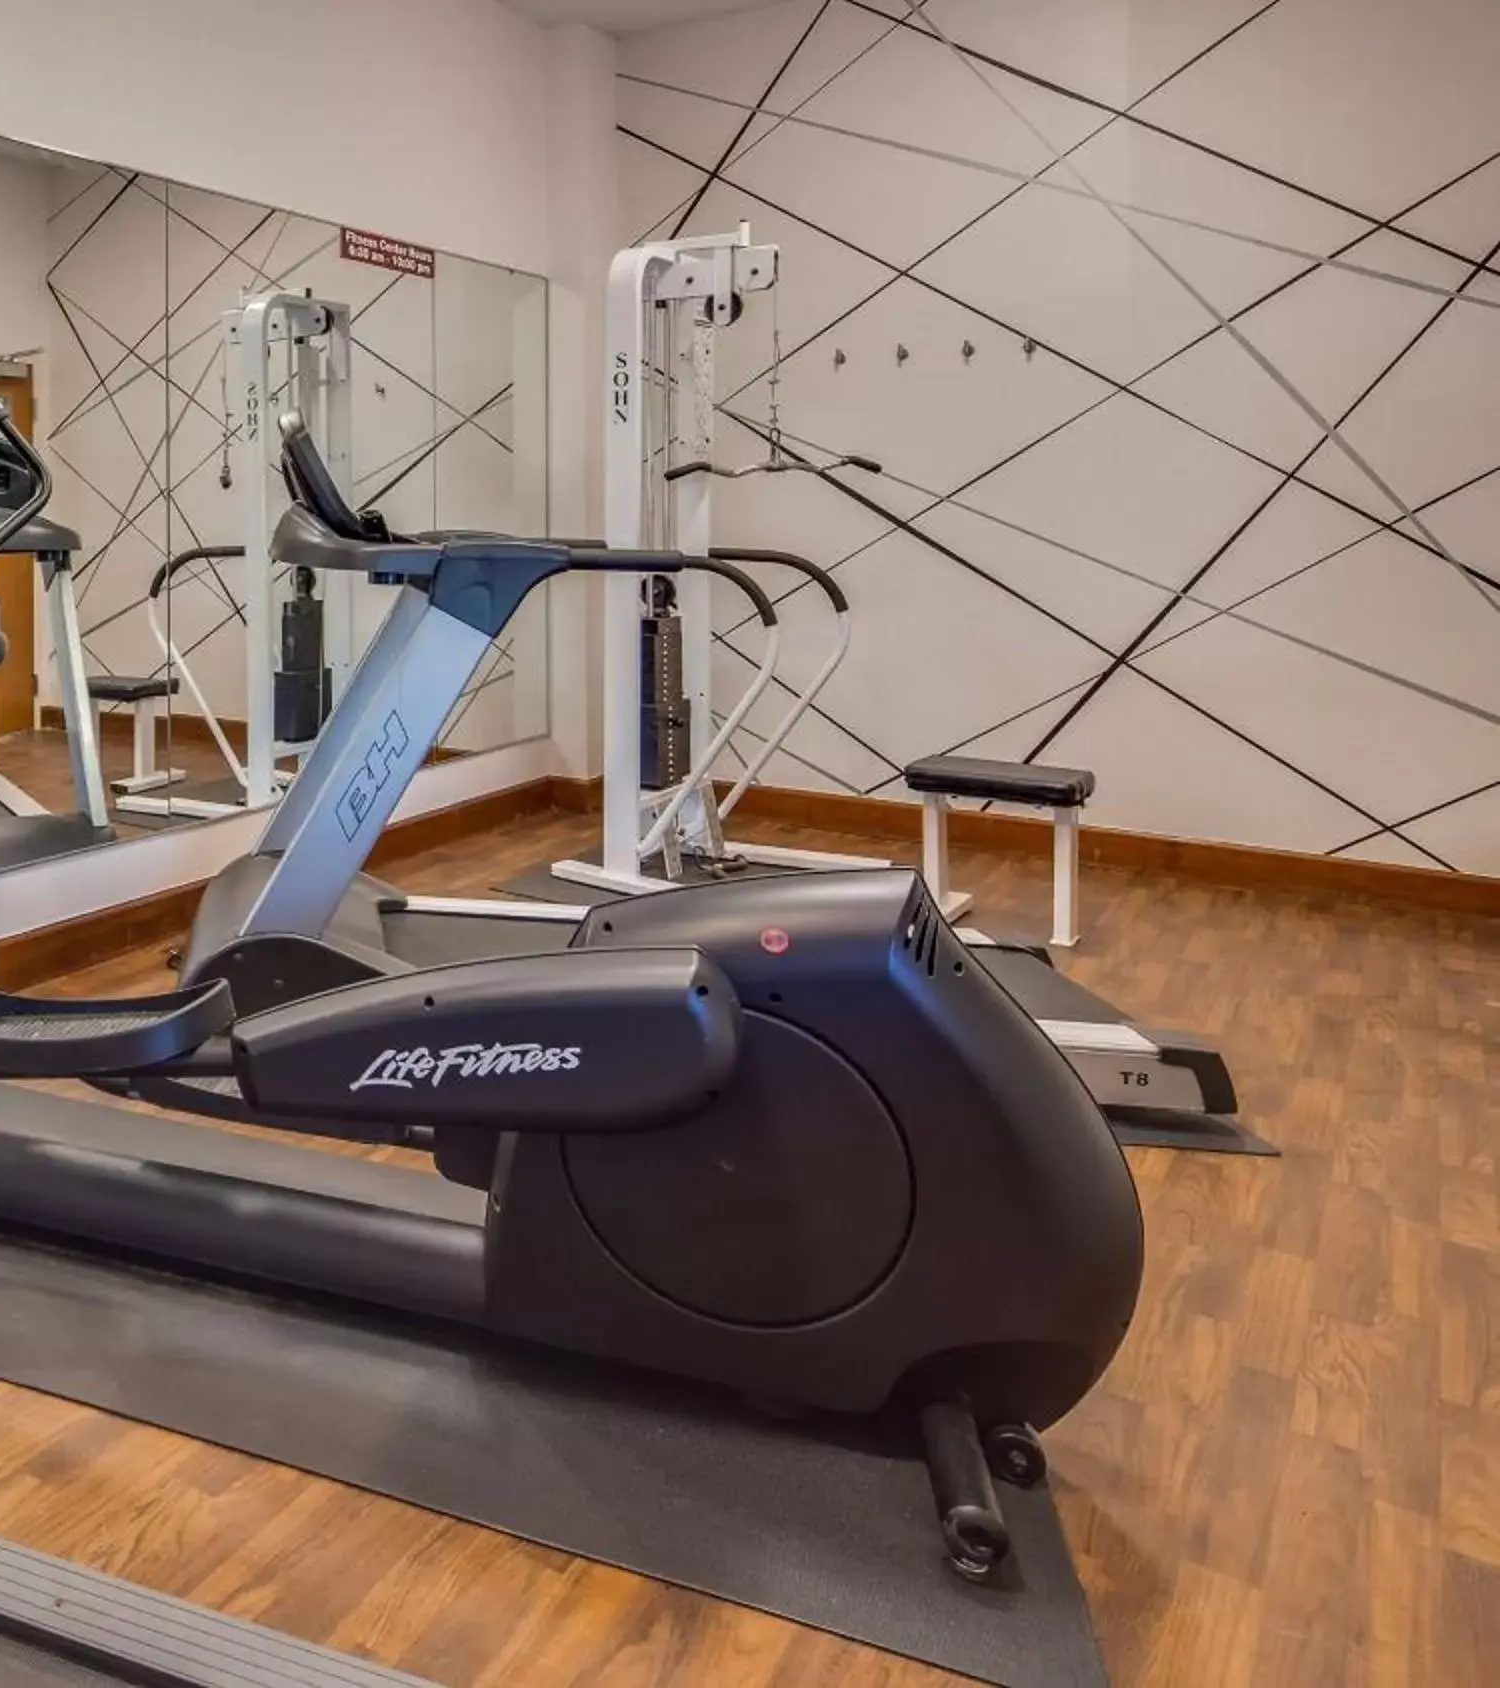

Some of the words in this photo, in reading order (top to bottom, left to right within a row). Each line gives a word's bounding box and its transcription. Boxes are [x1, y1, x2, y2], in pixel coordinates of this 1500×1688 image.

[345, 229, 378, 249] Fitness
[379, 239, 407, 256] Center
[613, 351, 629, 425] SOHN
[1119, 1071, 1149, 1087] T8
